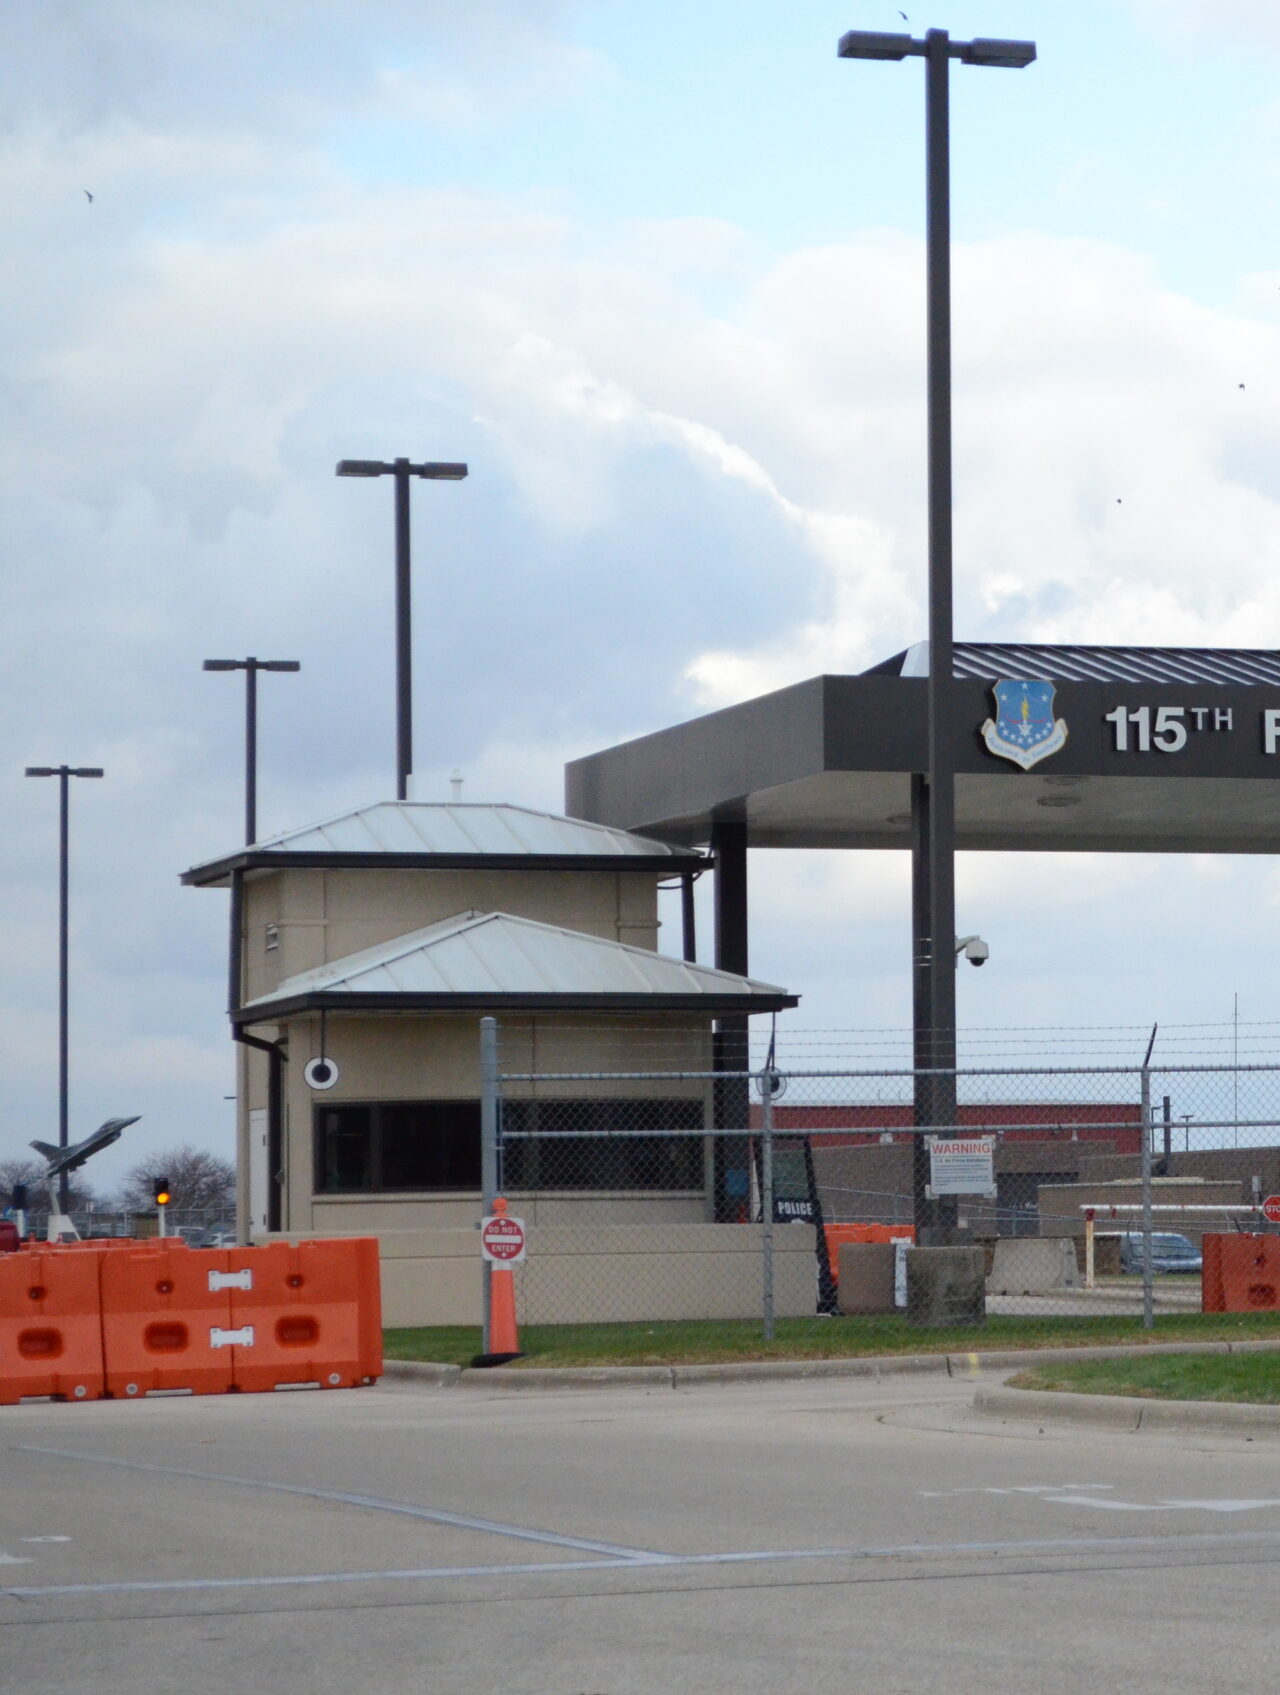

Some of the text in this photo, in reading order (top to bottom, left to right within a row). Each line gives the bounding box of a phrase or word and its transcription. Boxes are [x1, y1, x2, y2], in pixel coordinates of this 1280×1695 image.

[932, 1143, 990, 1154] WARNING
[778, 1201, 813, 1215] POLICE
[502, 1226, 518, 1234] NOT
[491, 1244, 516, 1252] ENTER
